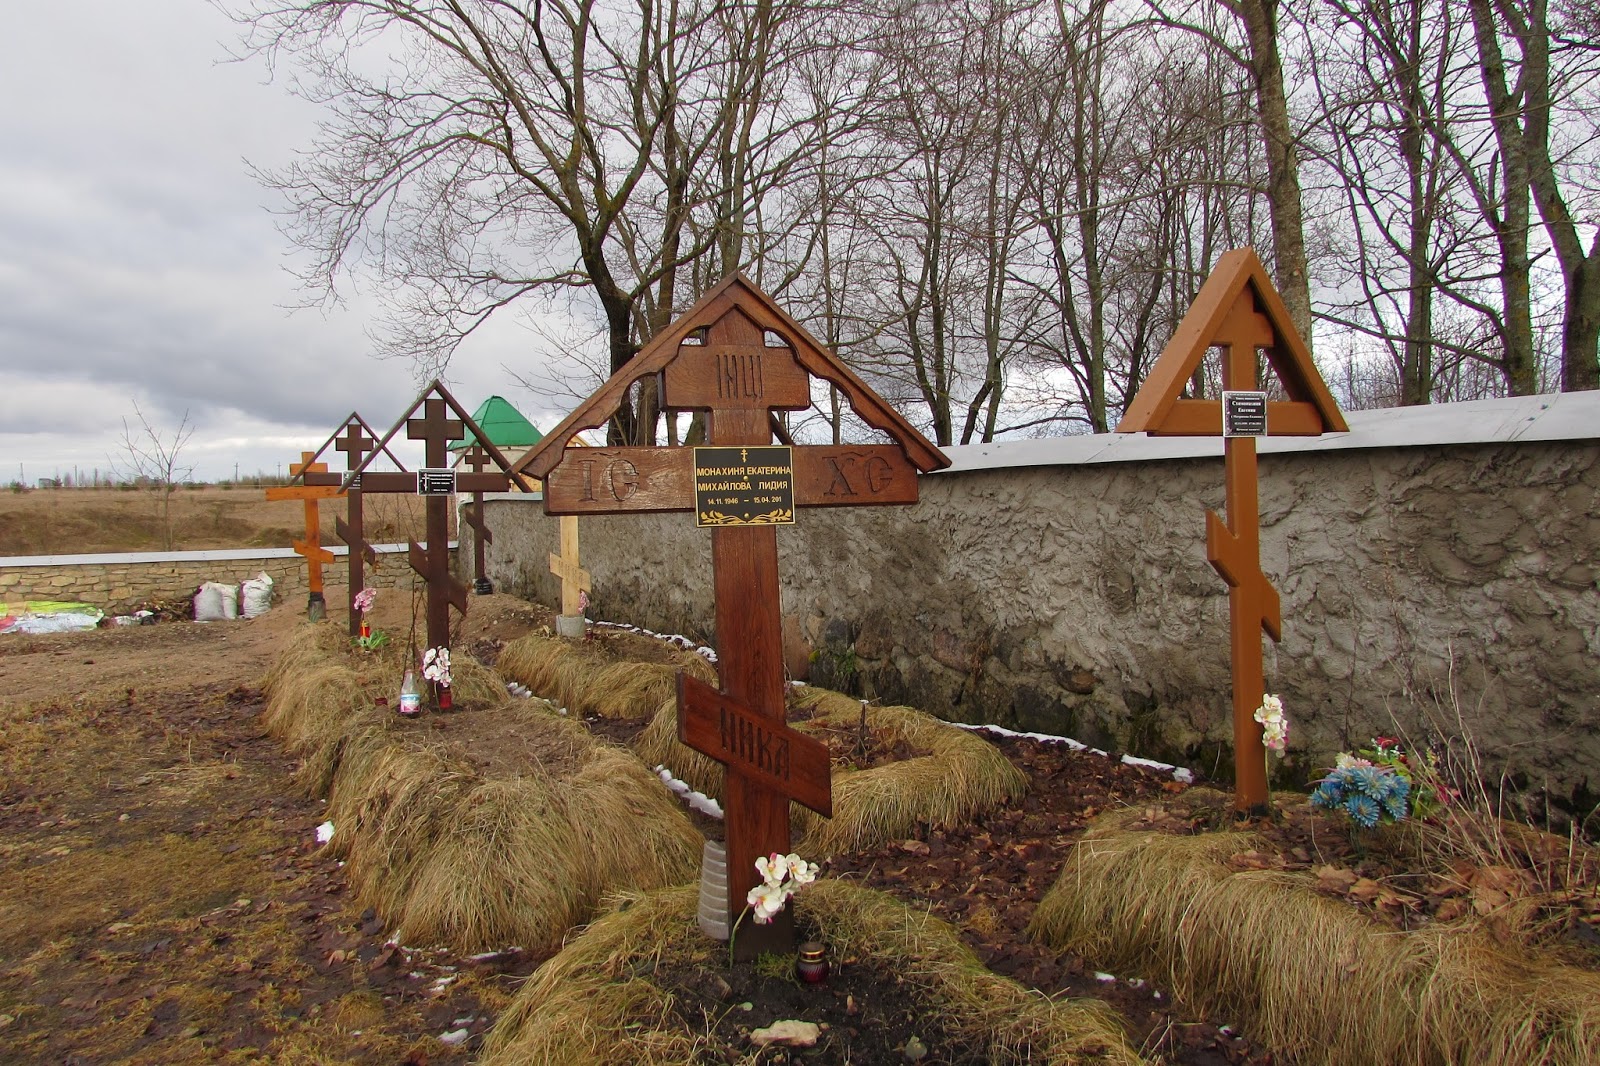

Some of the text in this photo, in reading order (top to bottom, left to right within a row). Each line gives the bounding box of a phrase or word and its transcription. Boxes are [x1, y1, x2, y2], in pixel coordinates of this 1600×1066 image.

[697, 466, 791, 476] МОНАХИНЯ ЕКАТЕРИНА
[698, 481, 788, 491] МИХАЙЛОВА ЛИДИЯ
